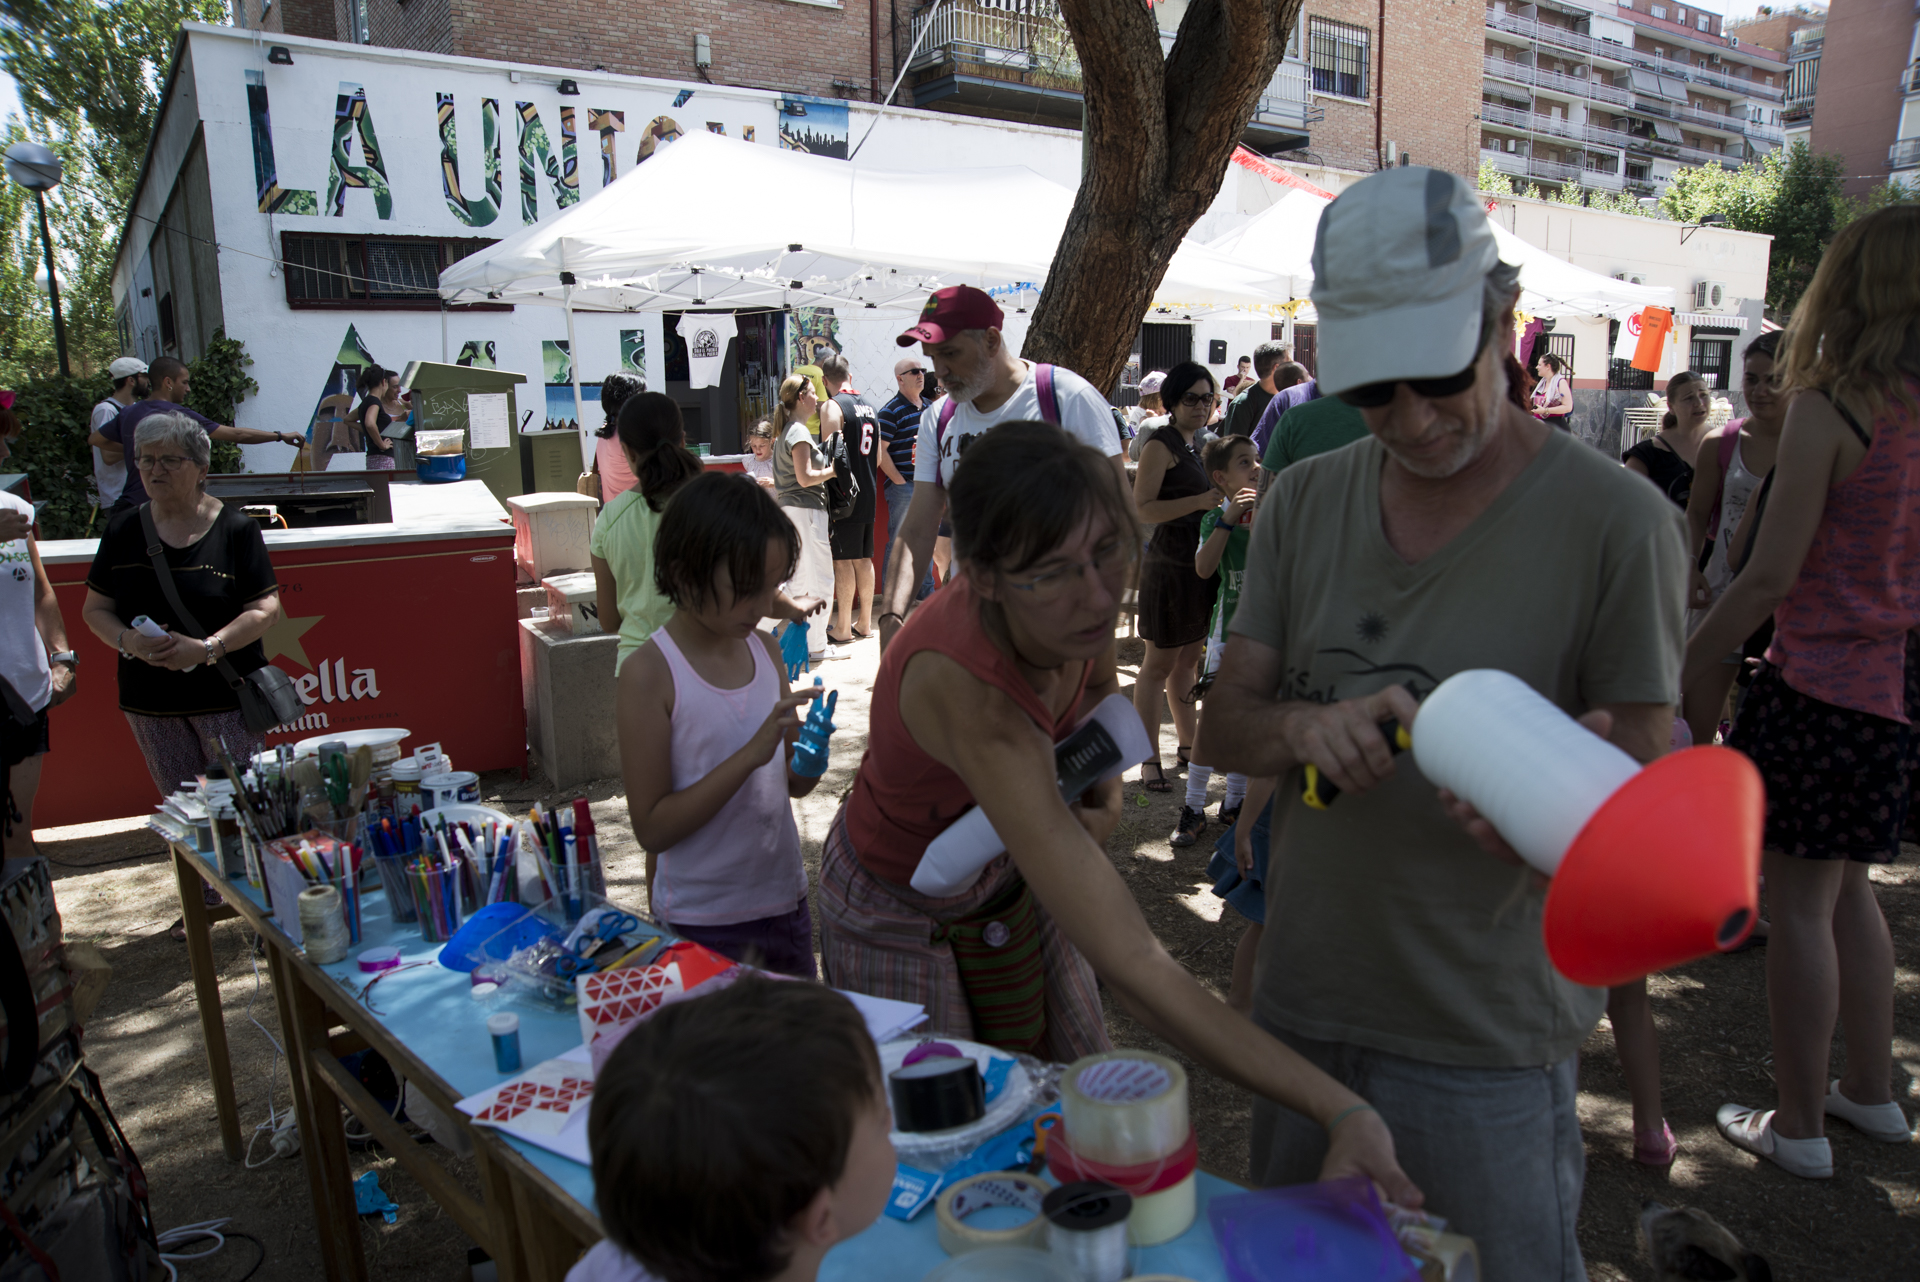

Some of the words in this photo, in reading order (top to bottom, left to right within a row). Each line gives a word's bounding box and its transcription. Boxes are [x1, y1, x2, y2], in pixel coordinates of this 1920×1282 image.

[244, 69, 397, 221] LA
[436, 90, 756, 227] UNI
[853, 404, 876, 419] JAMES
[860, 423, 874, 456] 6
[280, 583, 303, 593] 76
[332, 712, 399, 724] CERVECERA
